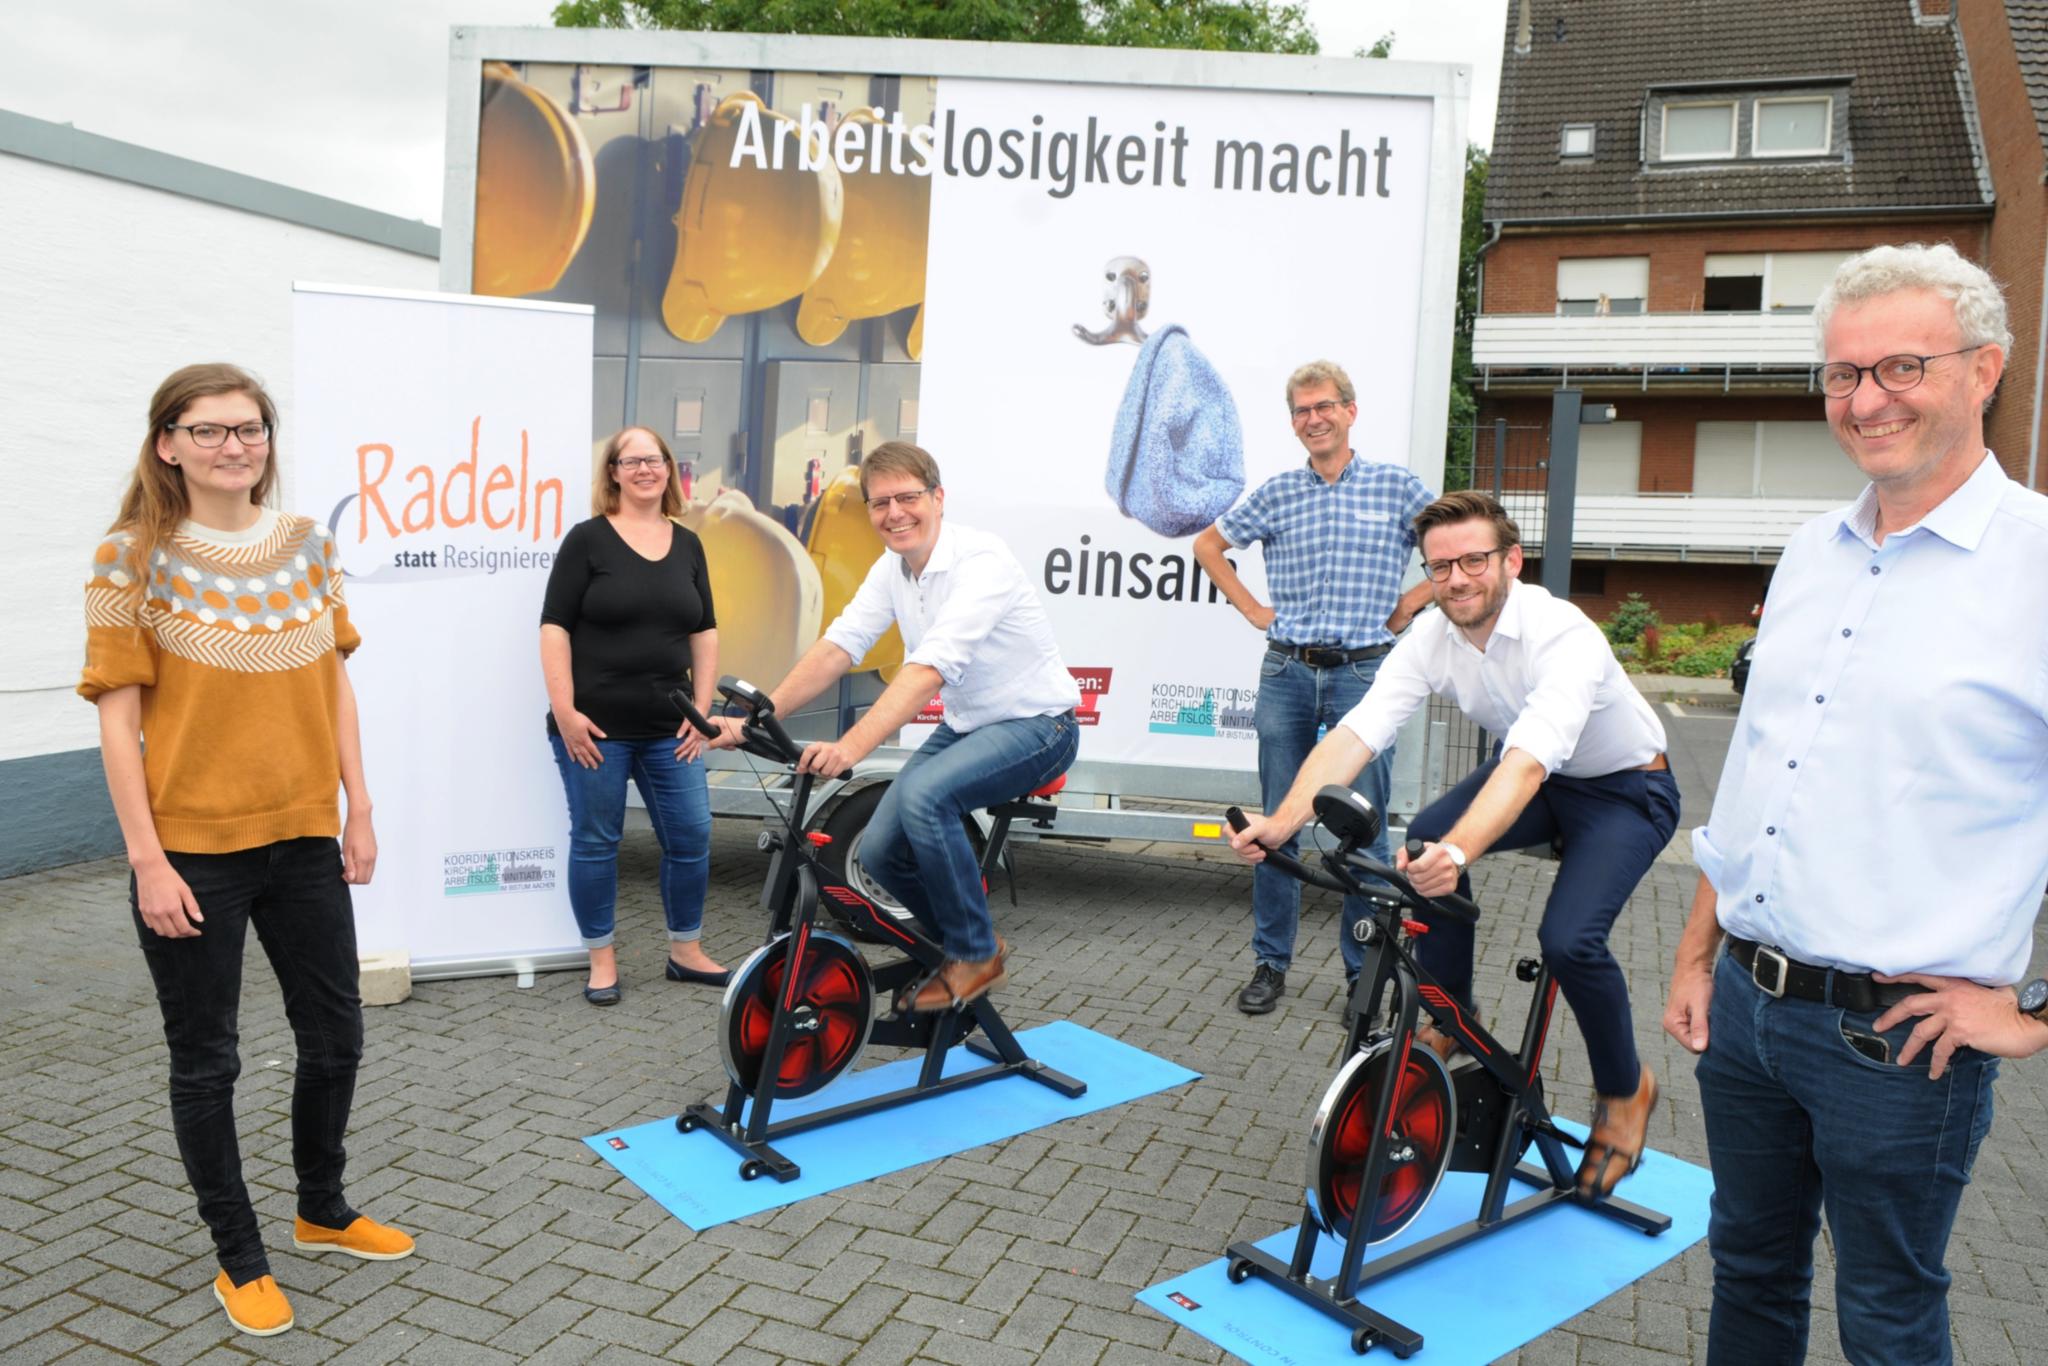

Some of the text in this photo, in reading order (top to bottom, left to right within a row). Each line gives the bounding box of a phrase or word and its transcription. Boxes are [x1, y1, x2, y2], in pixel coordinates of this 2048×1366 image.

[729, 101, 1392, 198] Arbeitslosigkeit macht
[356, 415, 563, 543] Radeln
[394, 550, 437, 568] statt
[1151, 698, 1219, 713] KIRCHLICHER
[444, 849, 555, 866] KOORDINATIONSKREIS
[444, 863, 501, 876] KIRCHLICHER
